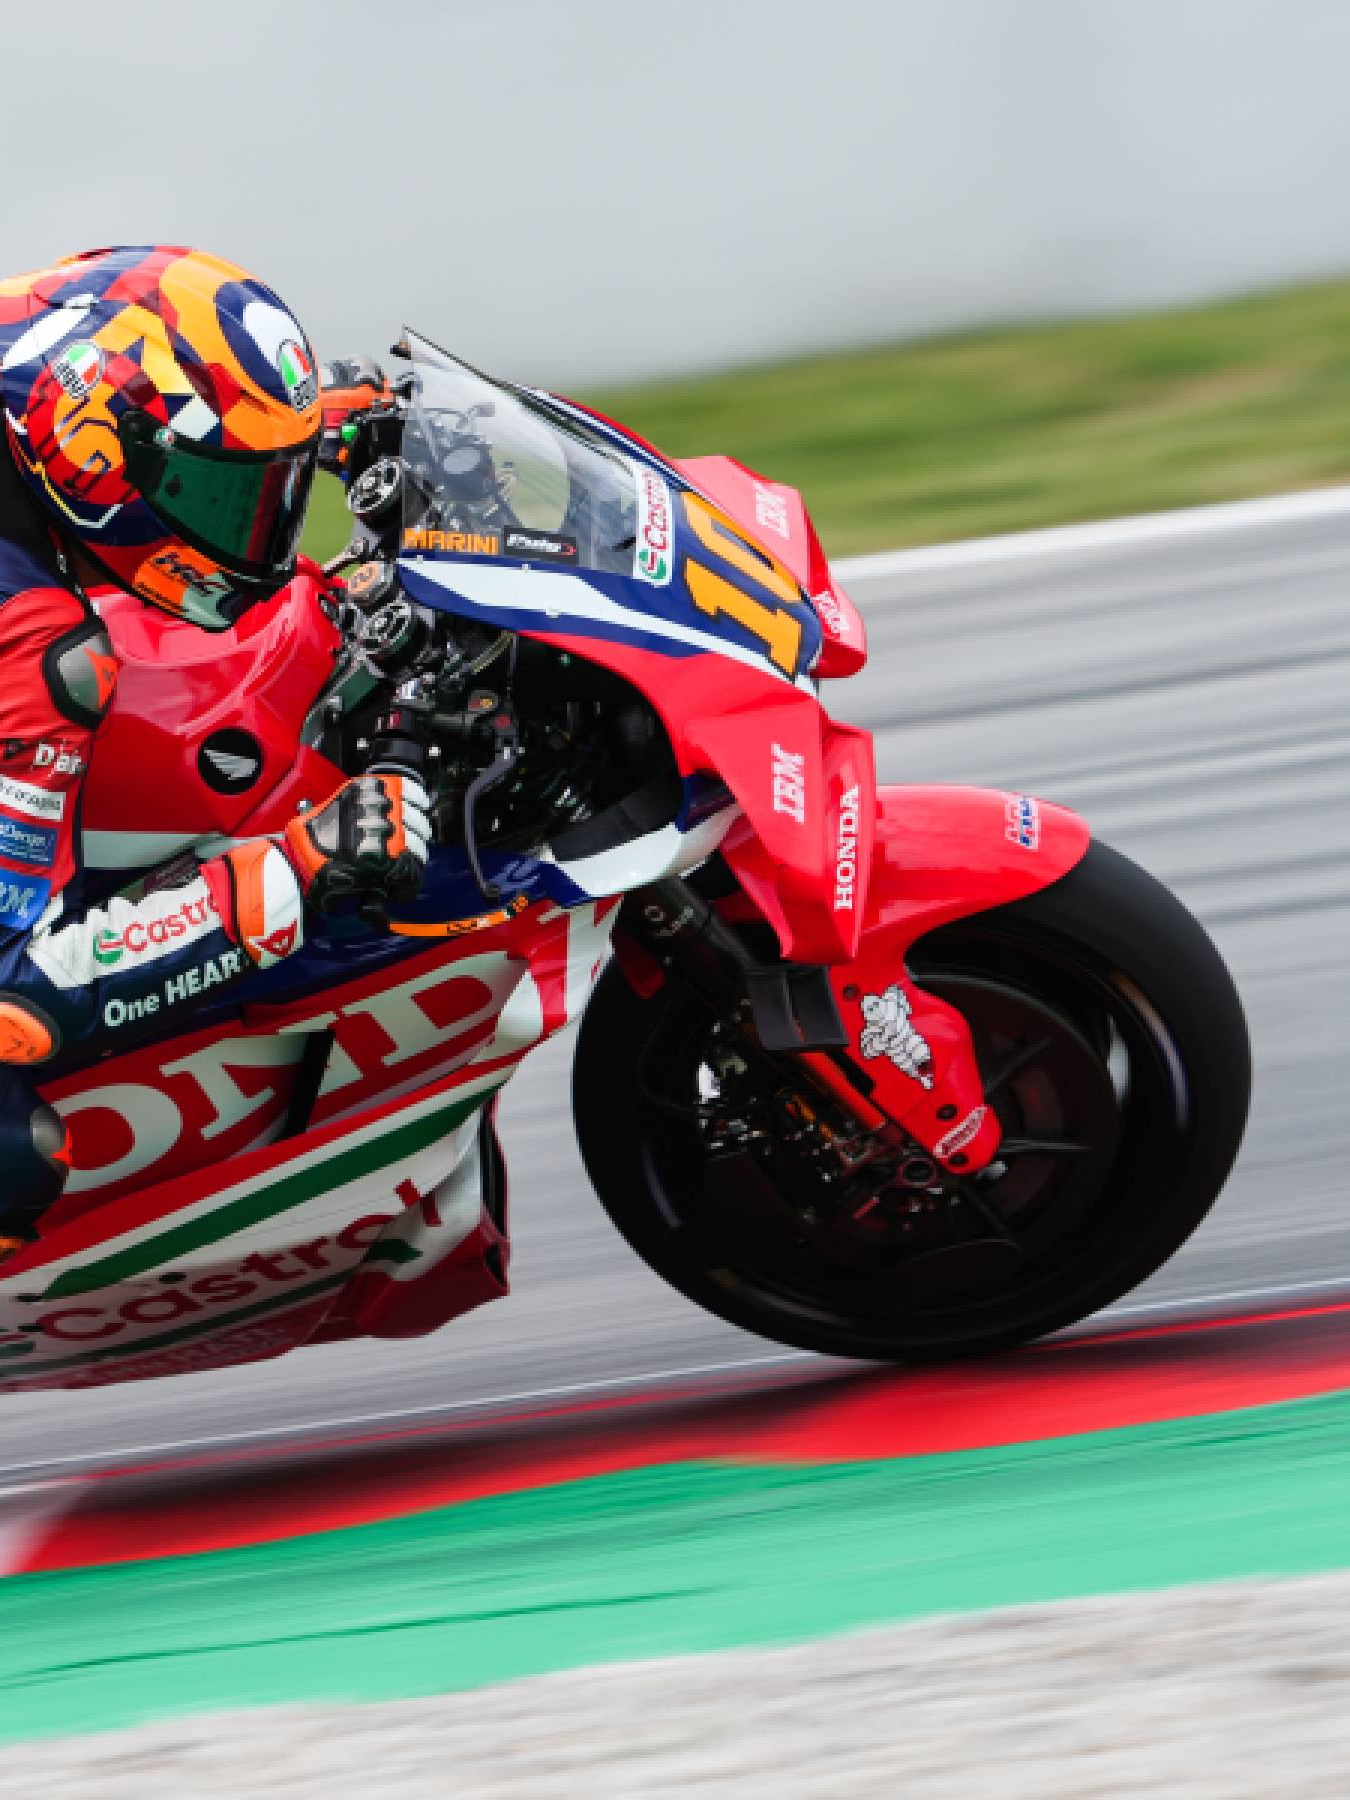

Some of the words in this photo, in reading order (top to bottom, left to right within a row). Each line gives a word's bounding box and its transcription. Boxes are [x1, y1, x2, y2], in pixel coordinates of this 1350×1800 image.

[401, 527, 499, 556] MARINI
[681, 490, 803, 679] 10
[770, 741, 805, 825] IBM
[833, 785, 860, 911] HONDA
[122, 894, 220, 953] Castr
[103, 991, 161, 1027] One
[164, 947, 247, 1004] HEAR
[33, 1177, 443, 1341] Castrol
